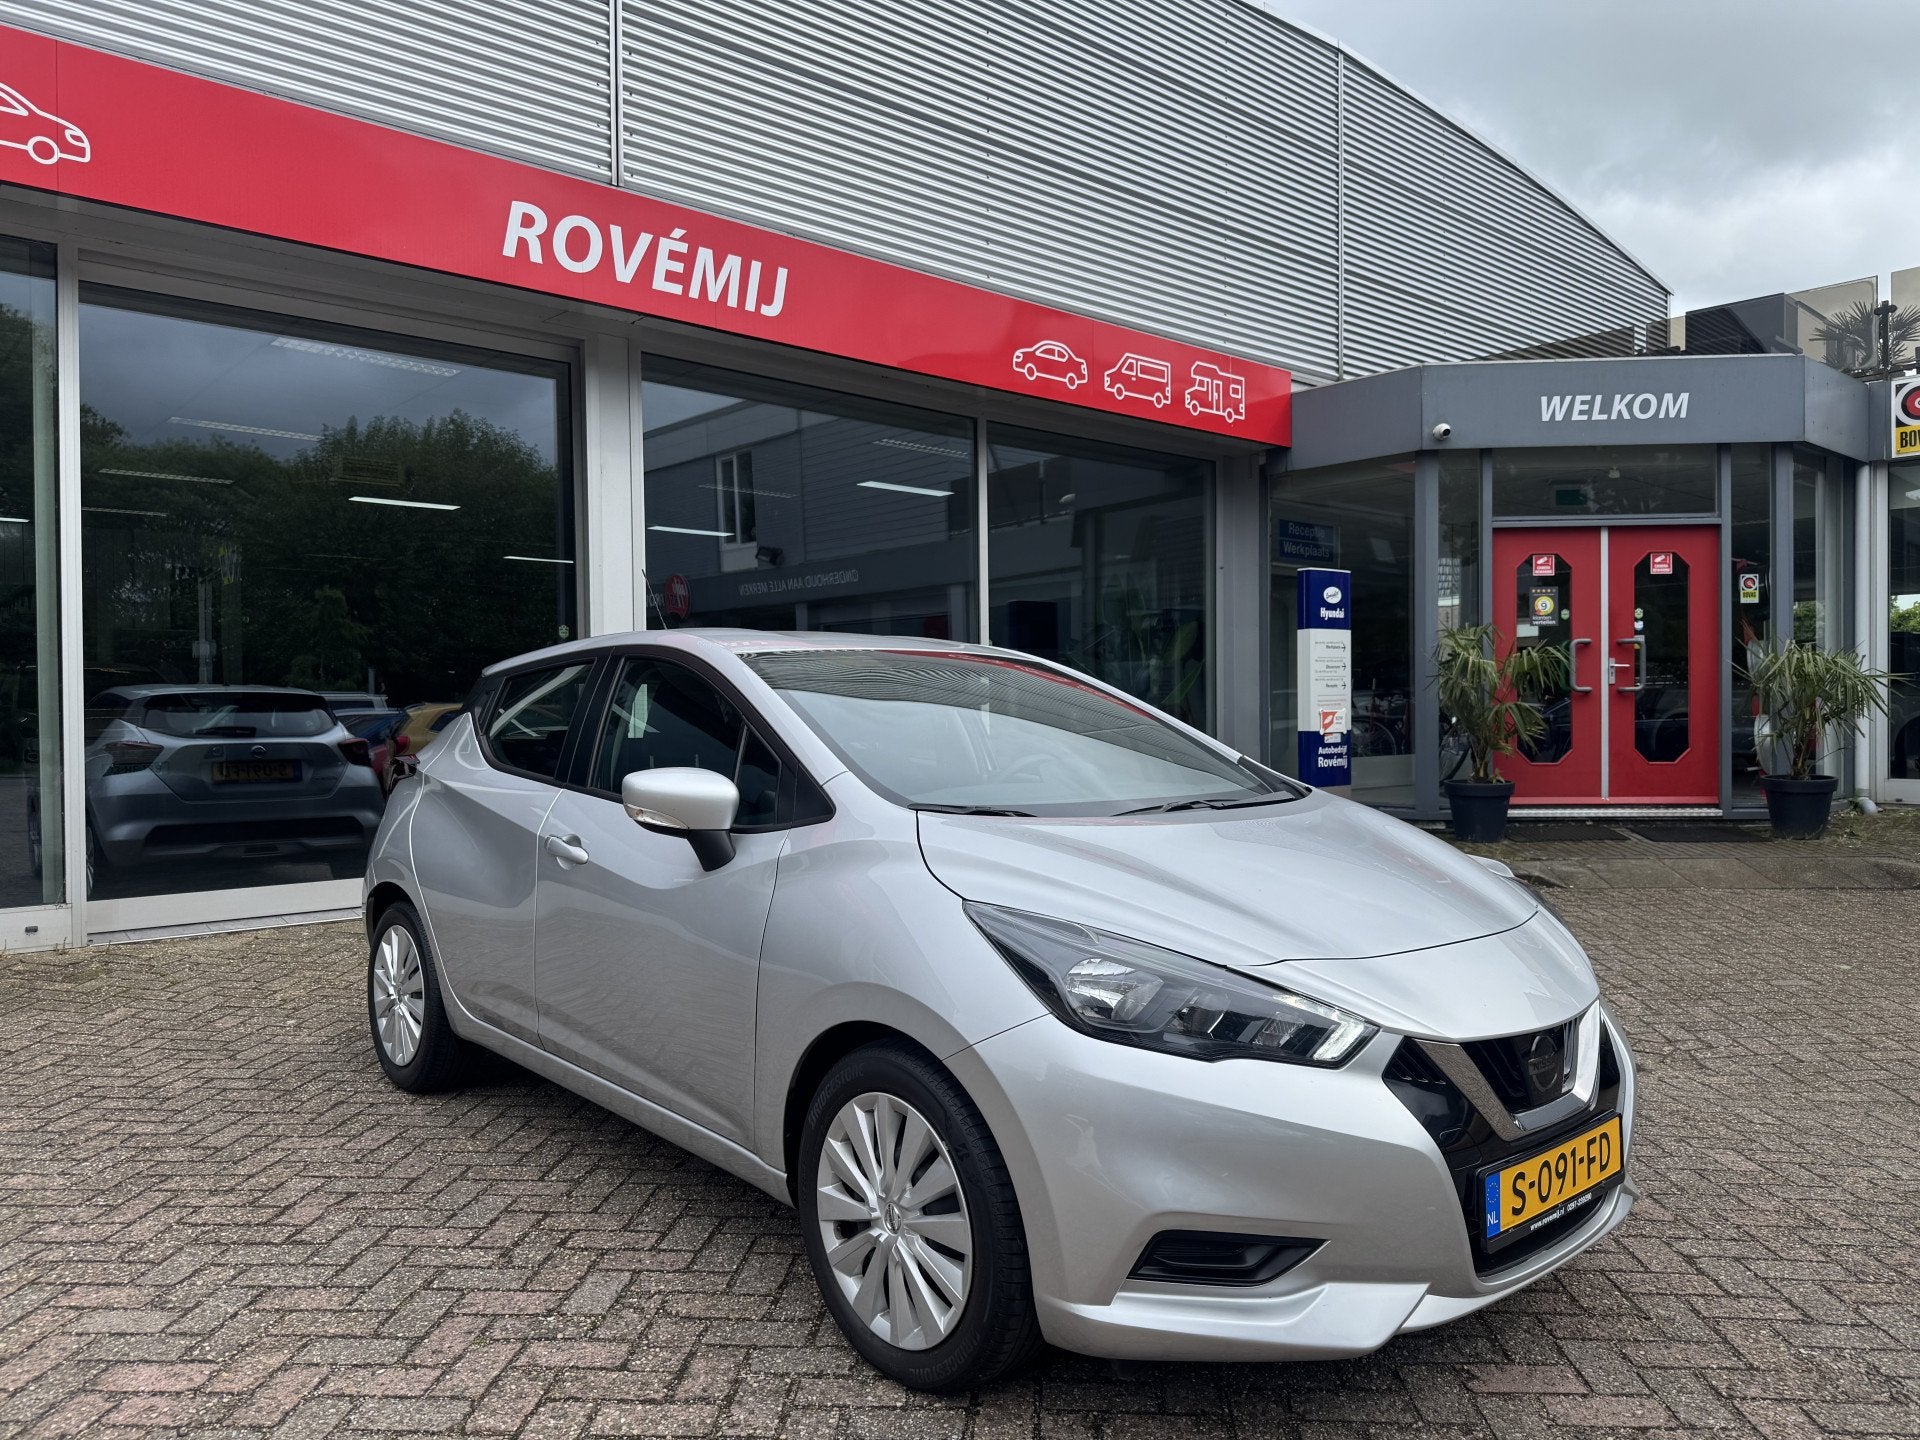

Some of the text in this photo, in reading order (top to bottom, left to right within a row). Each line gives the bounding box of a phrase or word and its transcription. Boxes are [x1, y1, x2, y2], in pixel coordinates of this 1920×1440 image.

[502, 200, 788, 317] ROVÉMIJ
[1540, 392, 1690, 421] WELKOM
[1283, 540, 1330, 558] Werkplaats
[1320, 607, 1345, 621] Hyundai
[1540, 602, 1548, 610] 9
[1318, 755, 1348, 769] Rovémij
[1511, 1131, 1611, 1216] S-091-FD
[1487, 1214, 1499, 1227] NL
